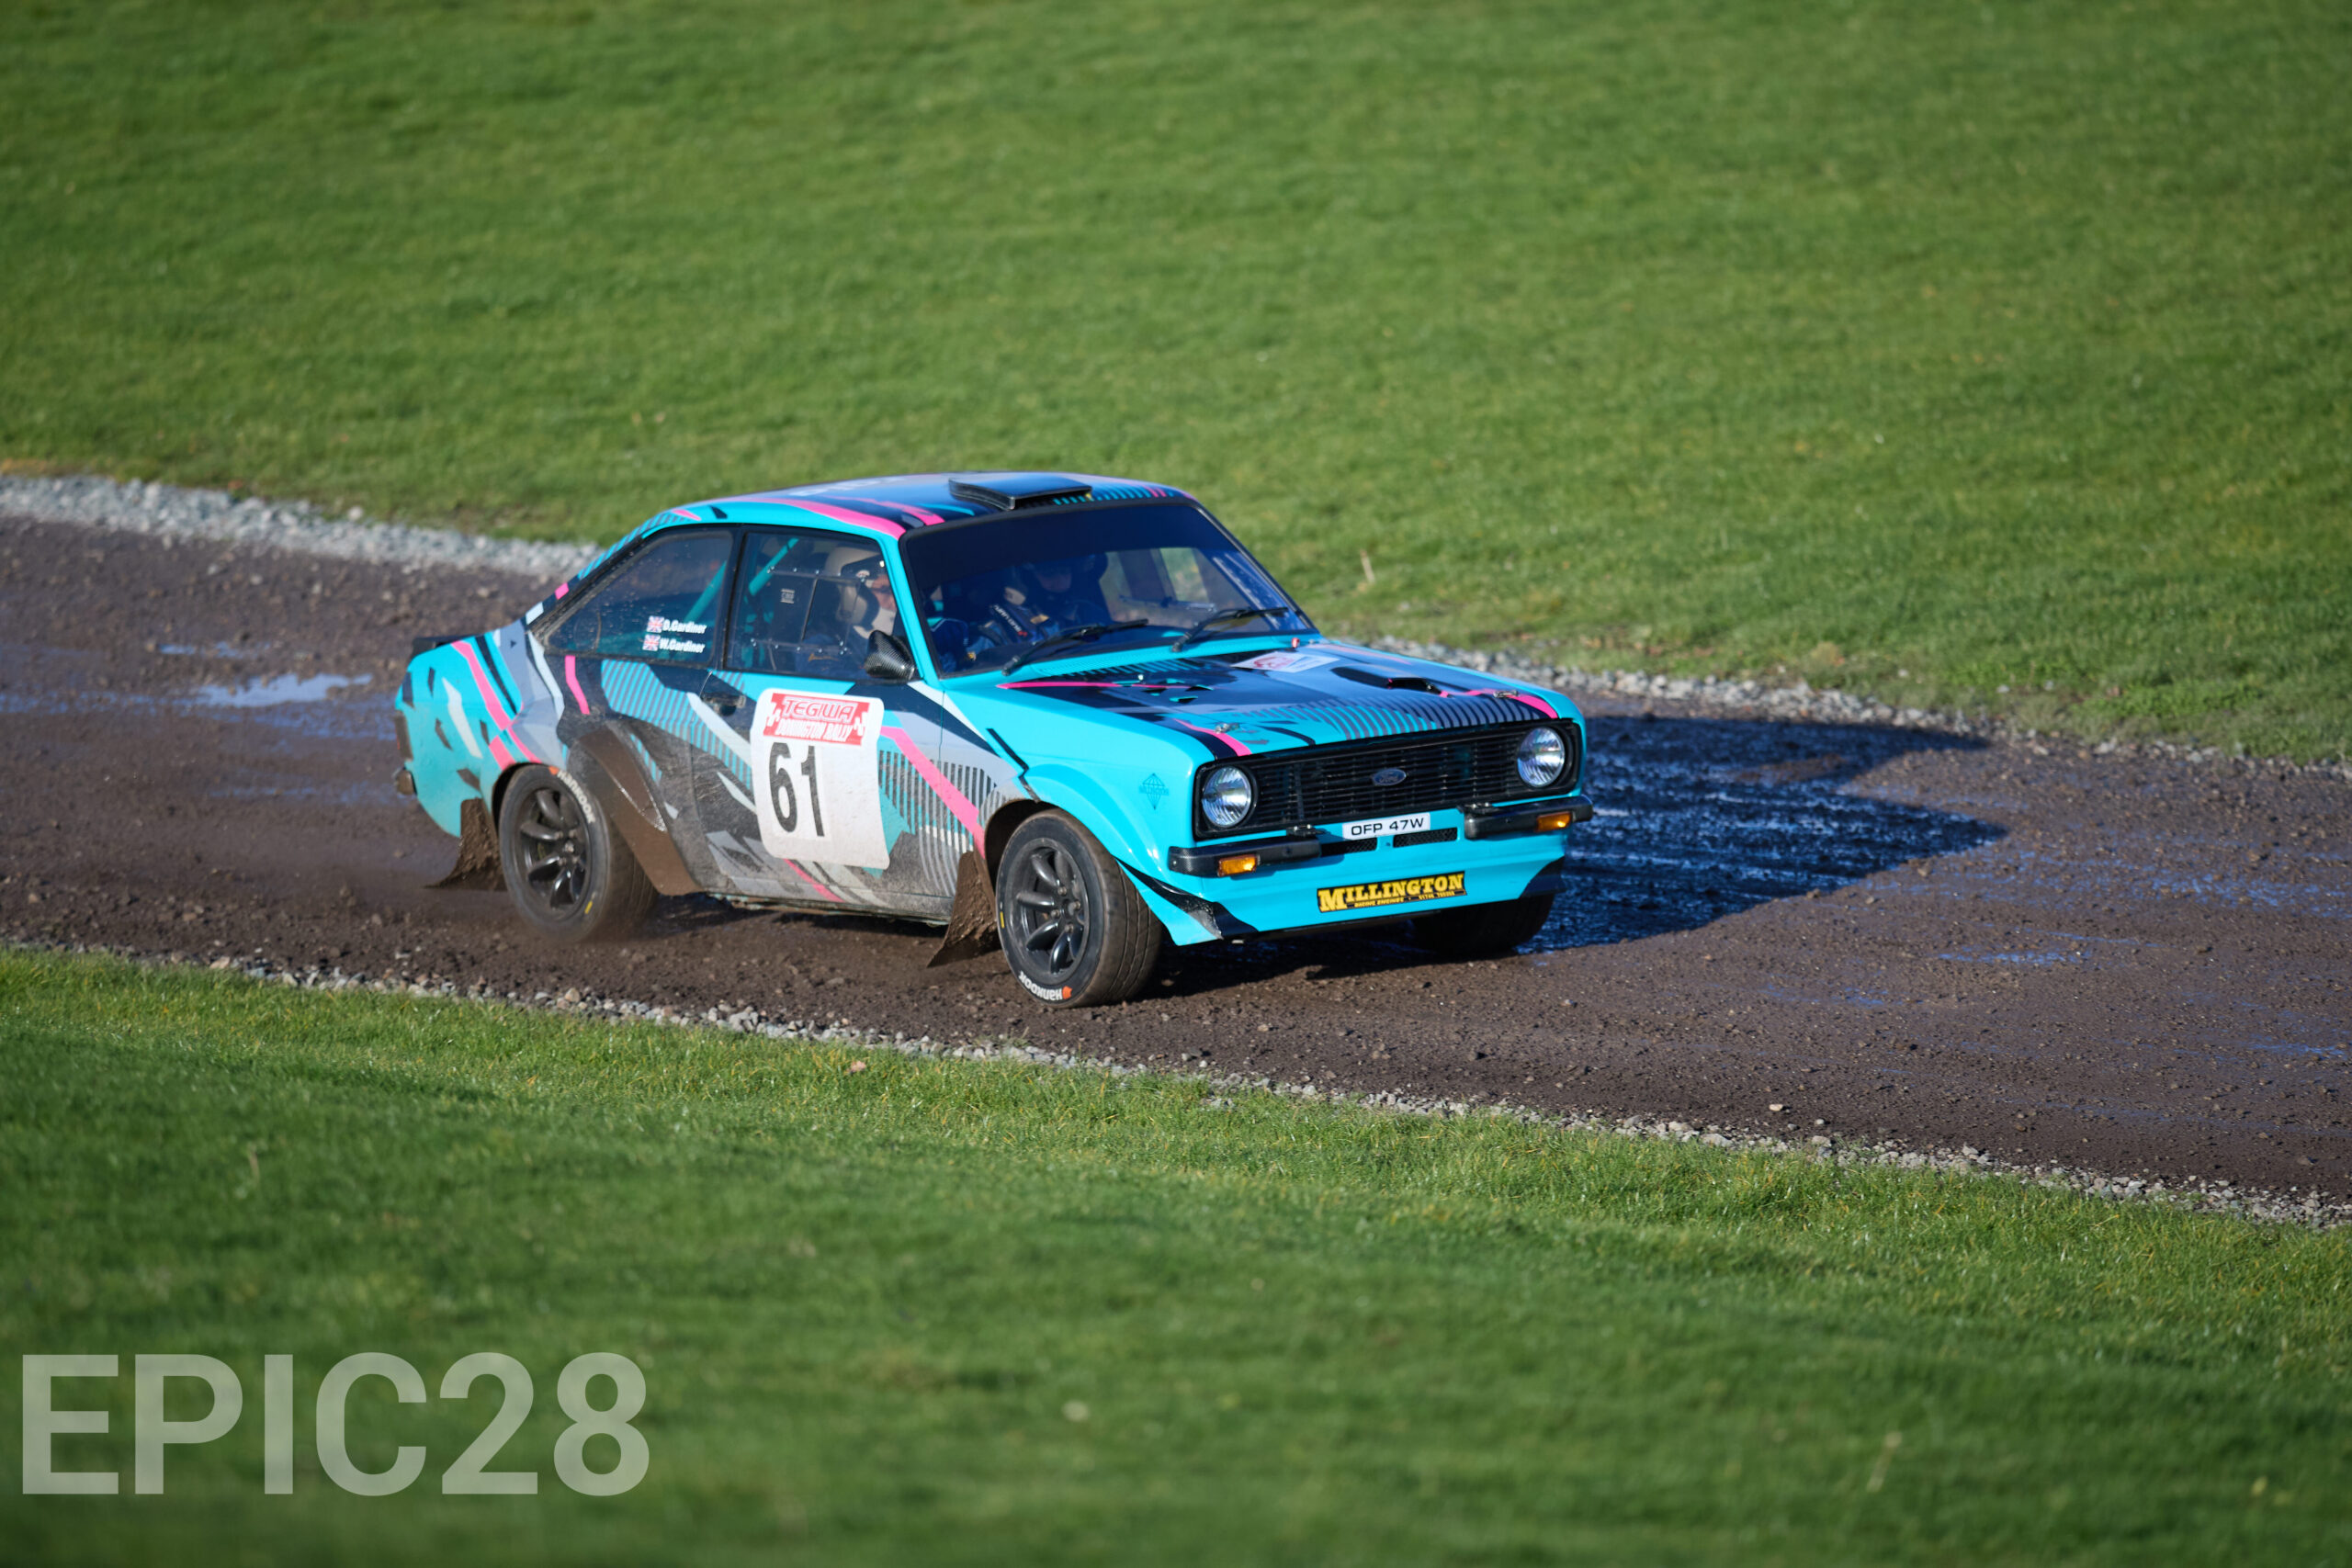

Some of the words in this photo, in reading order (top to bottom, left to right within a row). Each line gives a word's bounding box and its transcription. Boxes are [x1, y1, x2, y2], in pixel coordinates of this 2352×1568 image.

[662, 619, 707, 634] D.Gardiner
[659, 637, 706, 653] W.Gardiner
[784, 697, 856, 722] TEGIWA
[775, 718, 826, 739] DONINGTON
[823, 723, 854, 742] RALLY
[769, 742, 825, 837] 61
[1351, 823, 1383, 837] OFP
[1388, 817, 1424, 831] 47W
[1317, 874, 1464, 912] MILLINGTON
